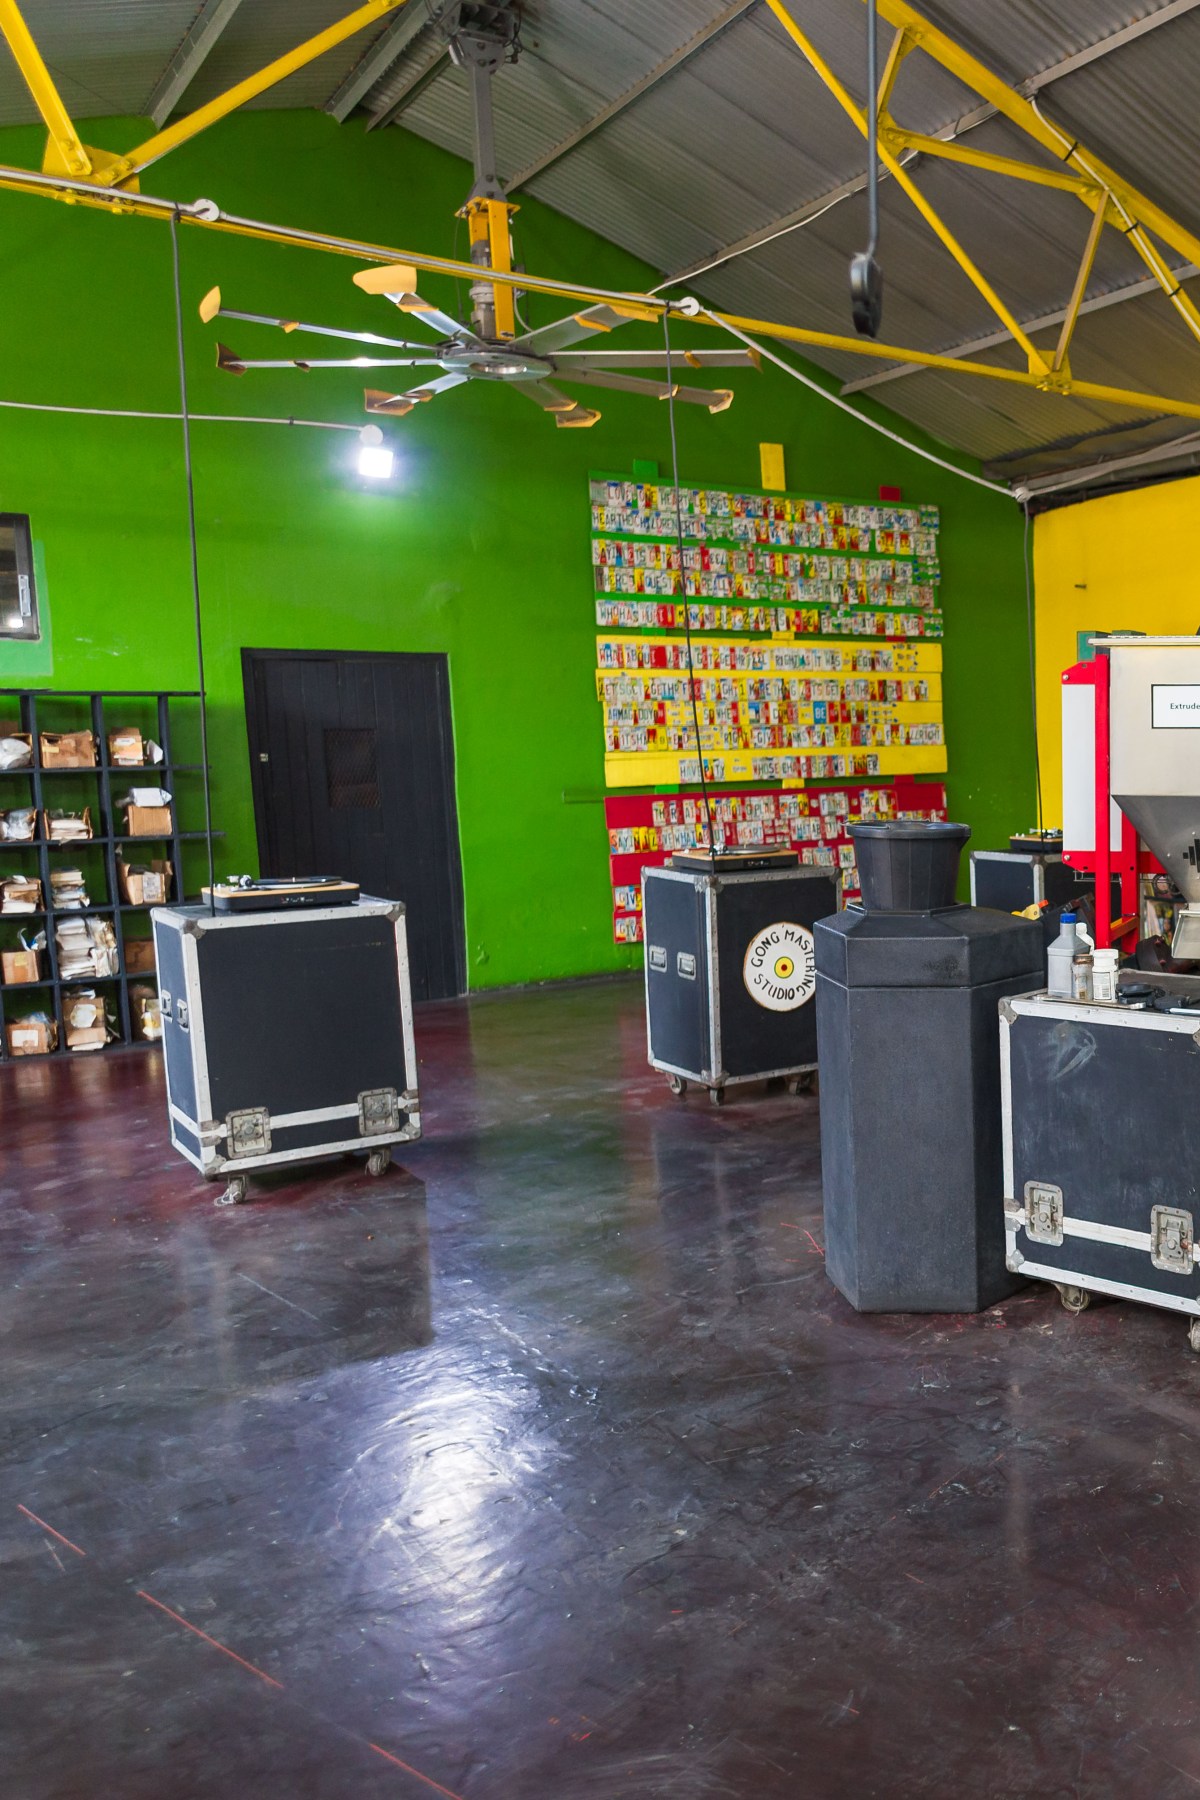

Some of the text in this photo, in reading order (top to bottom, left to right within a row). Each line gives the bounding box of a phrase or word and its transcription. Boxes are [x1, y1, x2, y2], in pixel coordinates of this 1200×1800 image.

[751, 931, 780, 968] GONG
[784, 929, 816, 997] MASTERING
[753, 973, 796, 1001] STUDIO
